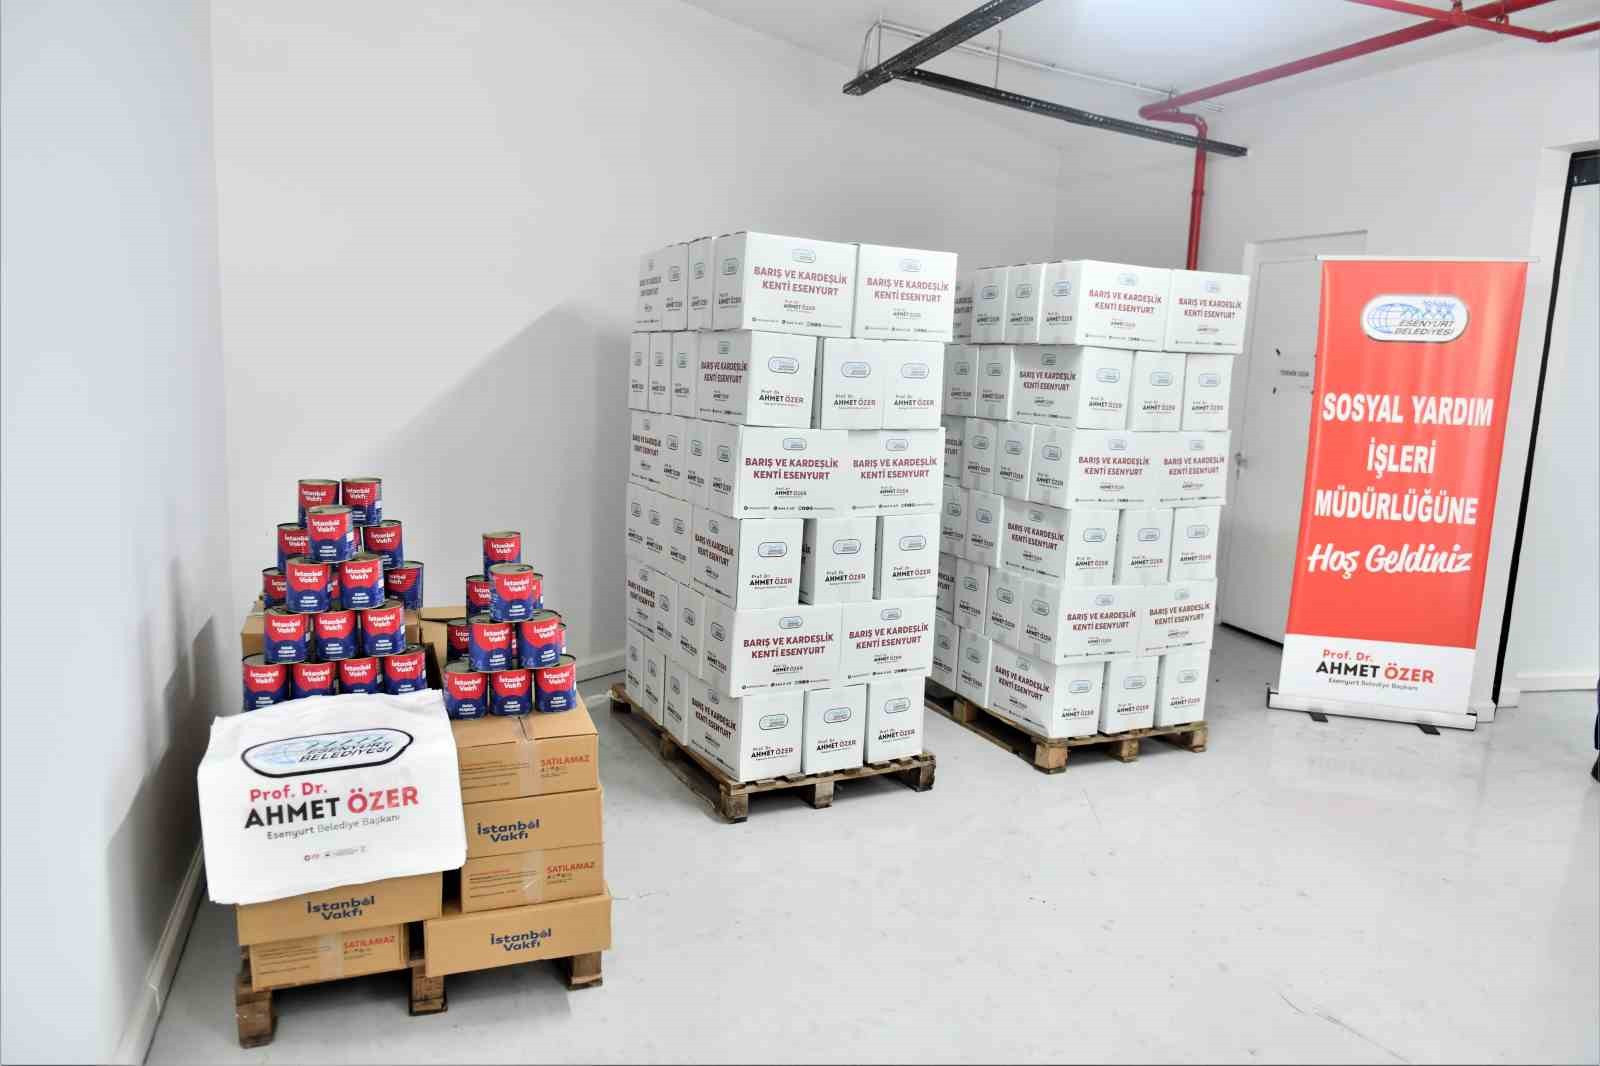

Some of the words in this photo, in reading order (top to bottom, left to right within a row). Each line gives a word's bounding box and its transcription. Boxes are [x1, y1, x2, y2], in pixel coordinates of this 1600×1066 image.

[785, 270, 796, 280] VE
[894, 280, 904, 289] VE
[759, 394, 784, 402] AHMET
[1323, 393, 1404, 422] SOSYAL
[1412, 396, 1493, 426] YARDIM
[775, 458, 786, 468] VE
[879, 458, 889, 467] VE
[1367, 438, 1436, 478] İŞLERİ
[1314, 485, 1479, 525] MÜDÜRLÜĞÜNE
[1307, 544, 1360, 579] Hoş
[1366, 544, 1472, 573] Geldiniz
[825, 573, 847, 583] AHMET
[892, 570, 913, 578] AHMET
[749, 578, 773, 586] AHMET
[875, 628, 885, 637] VE
[772, 636, 784, 646] VE
[1323, 649, 1351, 660] Prof.
[1357, 652, 1373, 662] Dr.
[1316, 662, 1380, 678] AHMET
[1384, 663, 1434, 683] ÖZER
[878, 733, 899, 741] AHMET
[816, 742, 838, 752] AHMET
[751, 750, 774, 759] AHMET
[250, 787, 295, 802] Prof.
[302, 782, 327, 795] Dr.
[244, 797, 340, 829] AHMET
[348, 786, 418, 813] ÖZER
[490, 831, 528, 842] Vakfı
[321, 908, 362, 920] Vakfı
[504, 940, 540, 951] Vakfı
